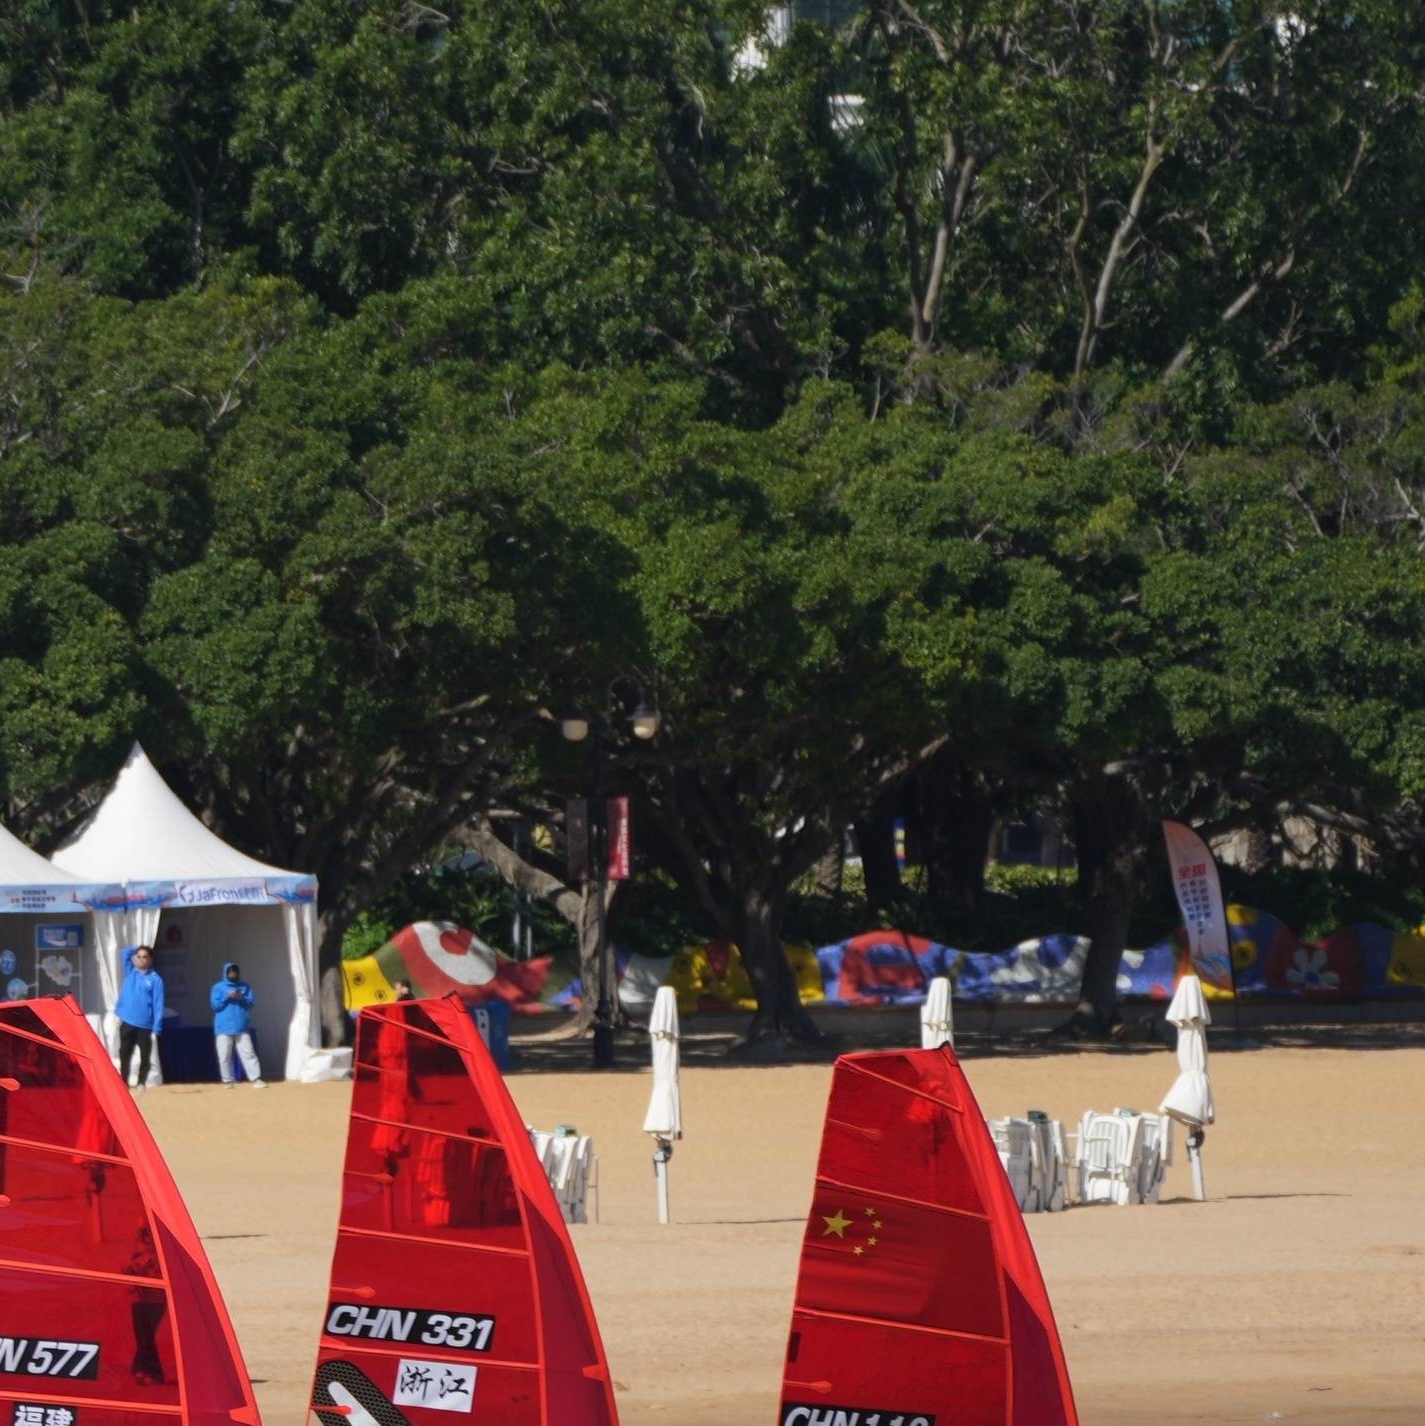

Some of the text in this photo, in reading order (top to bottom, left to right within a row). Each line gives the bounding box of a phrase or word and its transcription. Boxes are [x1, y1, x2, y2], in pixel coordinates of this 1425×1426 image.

[327, 1305, 494, 1350] CHN 331
[27, 1340, 99, 1377] 577
[400, 1365, 470, 1400] 浙江
